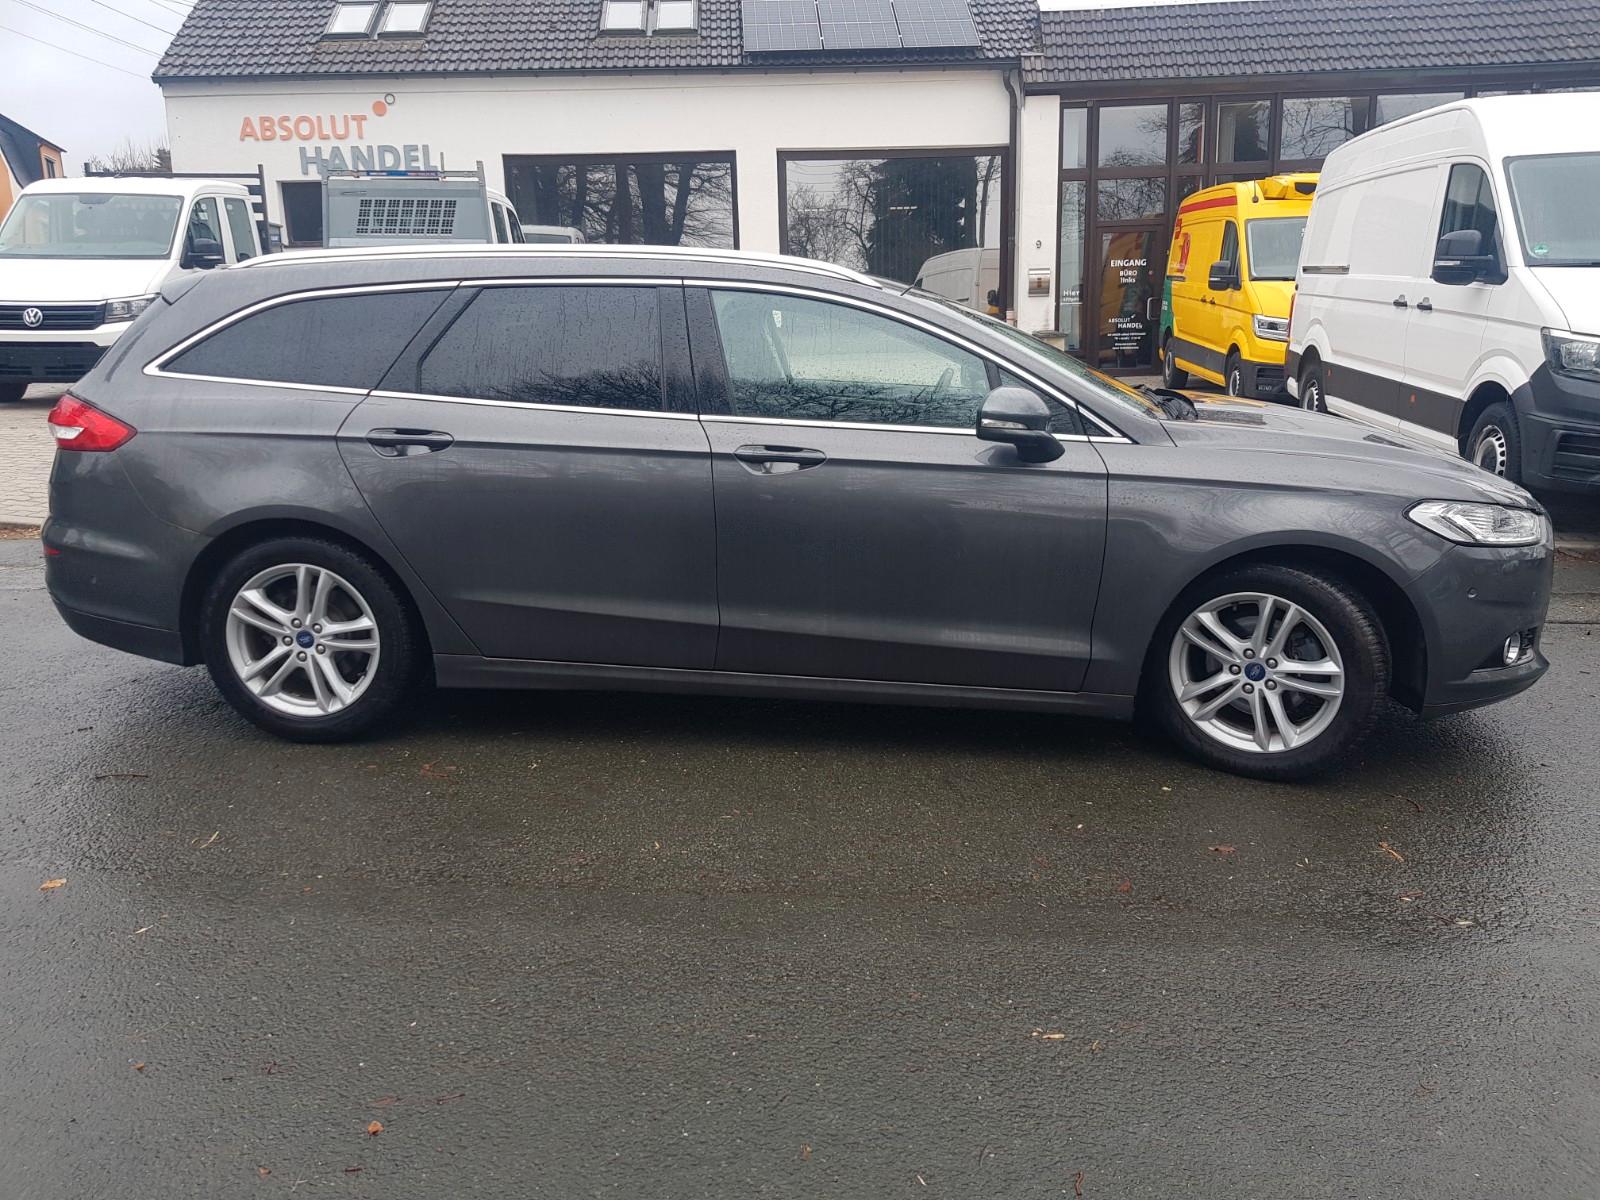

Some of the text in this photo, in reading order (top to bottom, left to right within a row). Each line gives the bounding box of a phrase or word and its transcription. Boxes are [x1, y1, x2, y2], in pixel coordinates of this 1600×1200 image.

[239, 115, 368, 141] ABSOLUT
[298, 144, 438, 175] HANDEL
[1110, 259, 1147, 267] EINGANG
[1119, 269, 1138, 277] BÜRO
